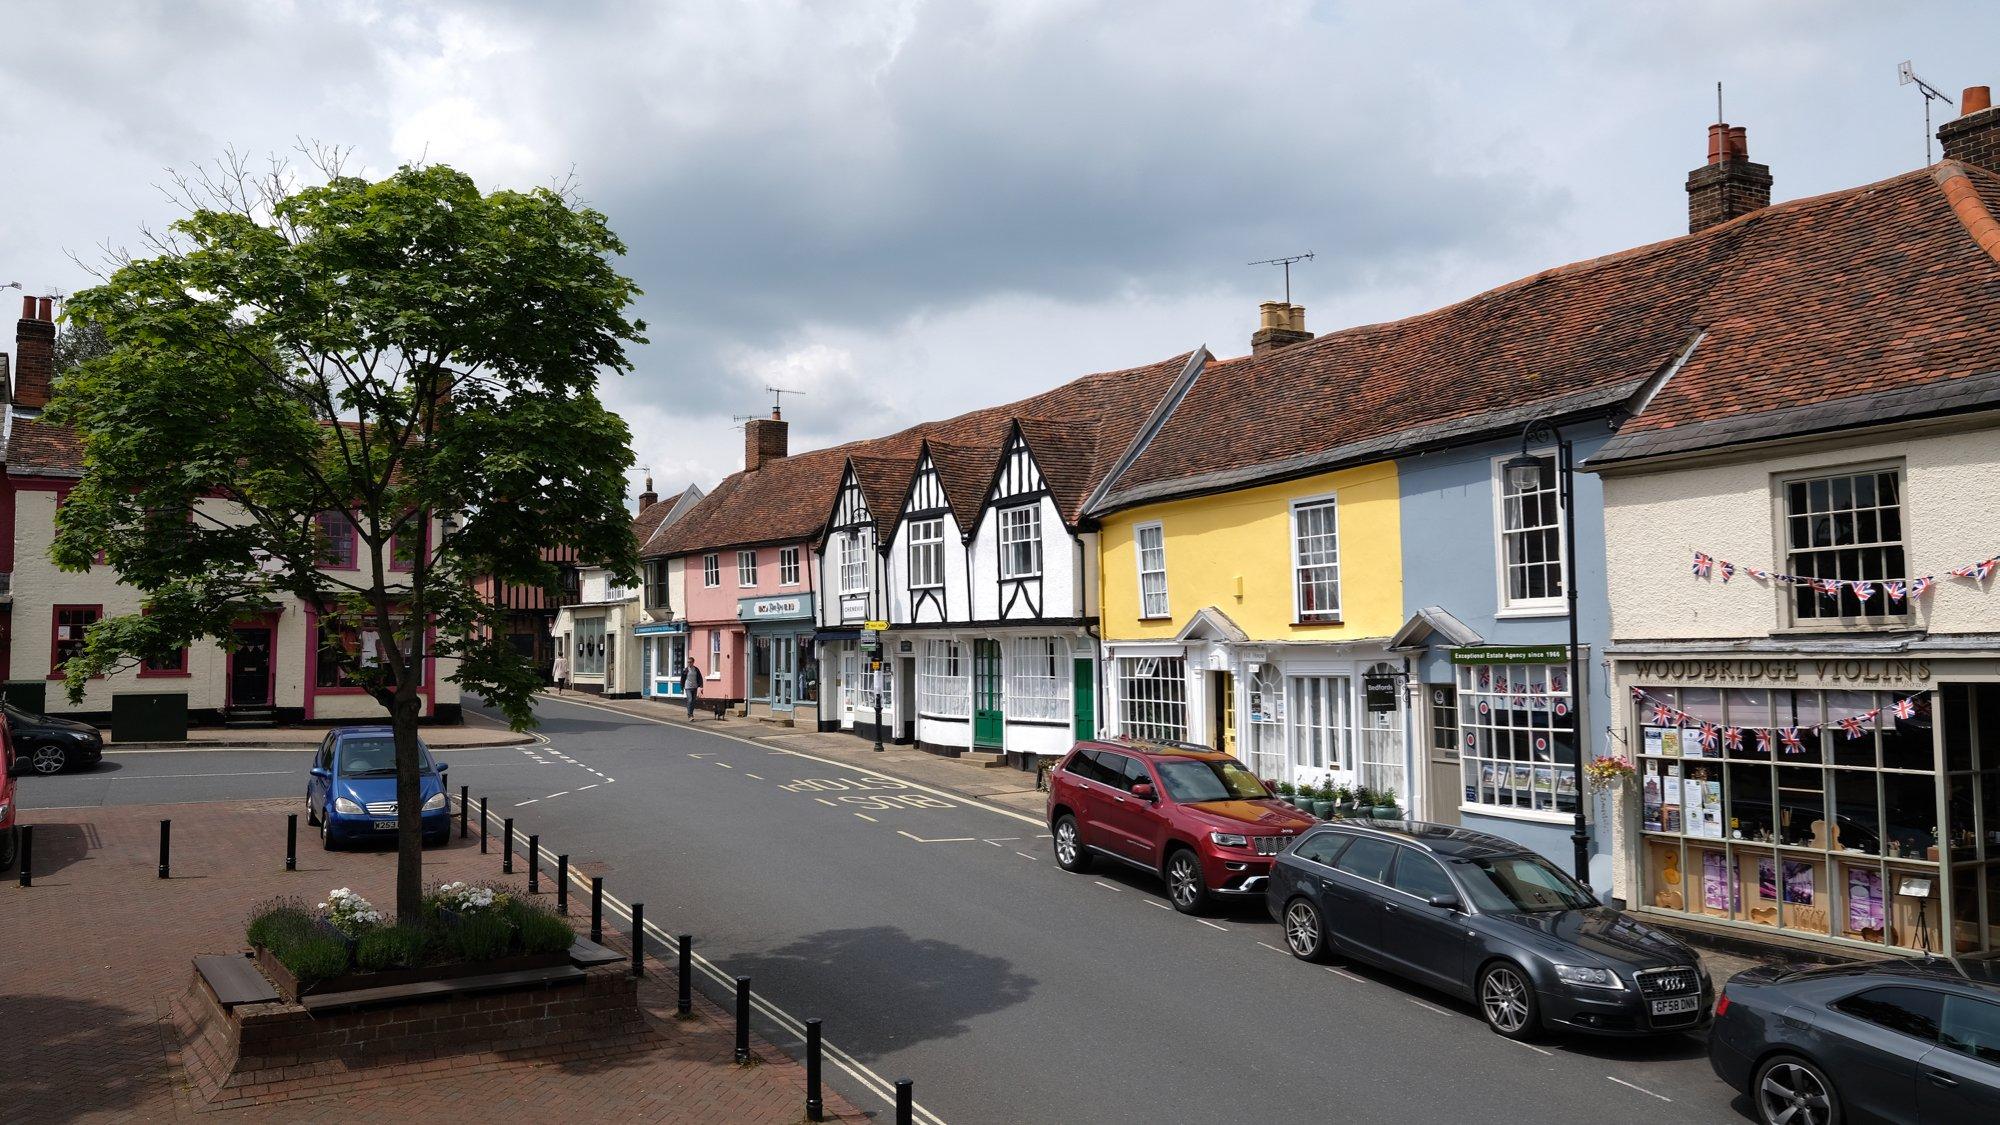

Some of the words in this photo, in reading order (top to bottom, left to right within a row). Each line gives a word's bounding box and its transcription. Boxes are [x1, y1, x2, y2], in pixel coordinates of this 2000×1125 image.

[1504, 652, 1526, 660] Agency
[1635, 660, 1798, 679] WOODBRIDGE
[1815, 660, 1931, 682] VIOLINS
[788, 777, 908, 791] STOP
[838, 794, 957, 809] BUS
[1656, 1001, 1679, 1012] GF58
